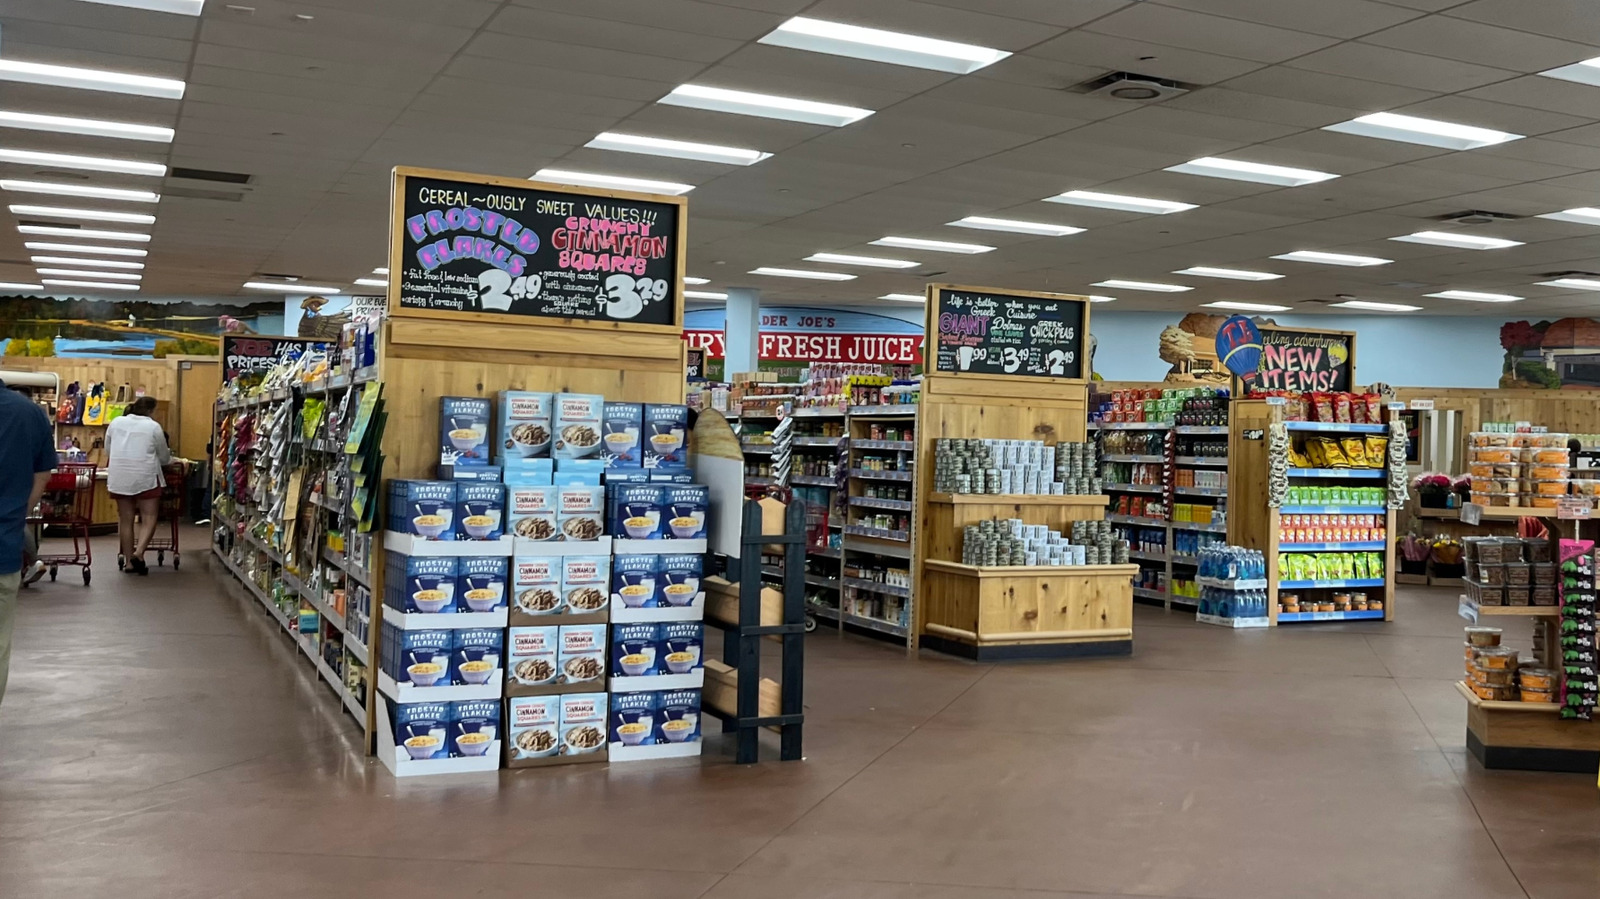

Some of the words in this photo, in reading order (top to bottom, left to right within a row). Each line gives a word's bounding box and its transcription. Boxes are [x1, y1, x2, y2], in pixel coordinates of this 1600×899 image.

[536, 199, 575, 217] SWEET
[584, 203, 658, 226] VALUES!!!
[406, 206, 541, 255] FROSTED
[565, 216, 652, 237] CRUNCHY
[551, 227, 668, 259] CINNAMON
[416, 235, 528, 278] FLAKES
[558, 250, 647, 276] SQUARES
[466, 269, 542, 311] $2.49
[970, 305, 996, 317] Greek
[1006, 307, 1038, 319] Cuisine
[1027, 303, 1041, 312] you
[1044, 303, 1059, 311] eat
[758, 315, 788, 327] DER
[797, 315, 836, 328] JOE'S
[939, 312, 990, 336] GIANT
[990, 316, 1026, 331] Dolmas
[1029, 324, 1075, 340] CHICKPEAS
[1037, 320, 1064, 328] GREEK
[229, 338, 274, 356] JOE
[760, 335, 842, 360] FRESH
[848, 337, 915, 361] JUICE
[1000, 347, 1030, 374] $3.49
[1264, 344, 1322, 372] NEW
[1261, 368, 1339, 392] ITEMS!
[415, 486, 451, 494] FROSTED
[409, 633, 447, 641] FROSTED
[406, 706, 444, 714] FROSTED
[458, 703, 495, 711] FROSTED
